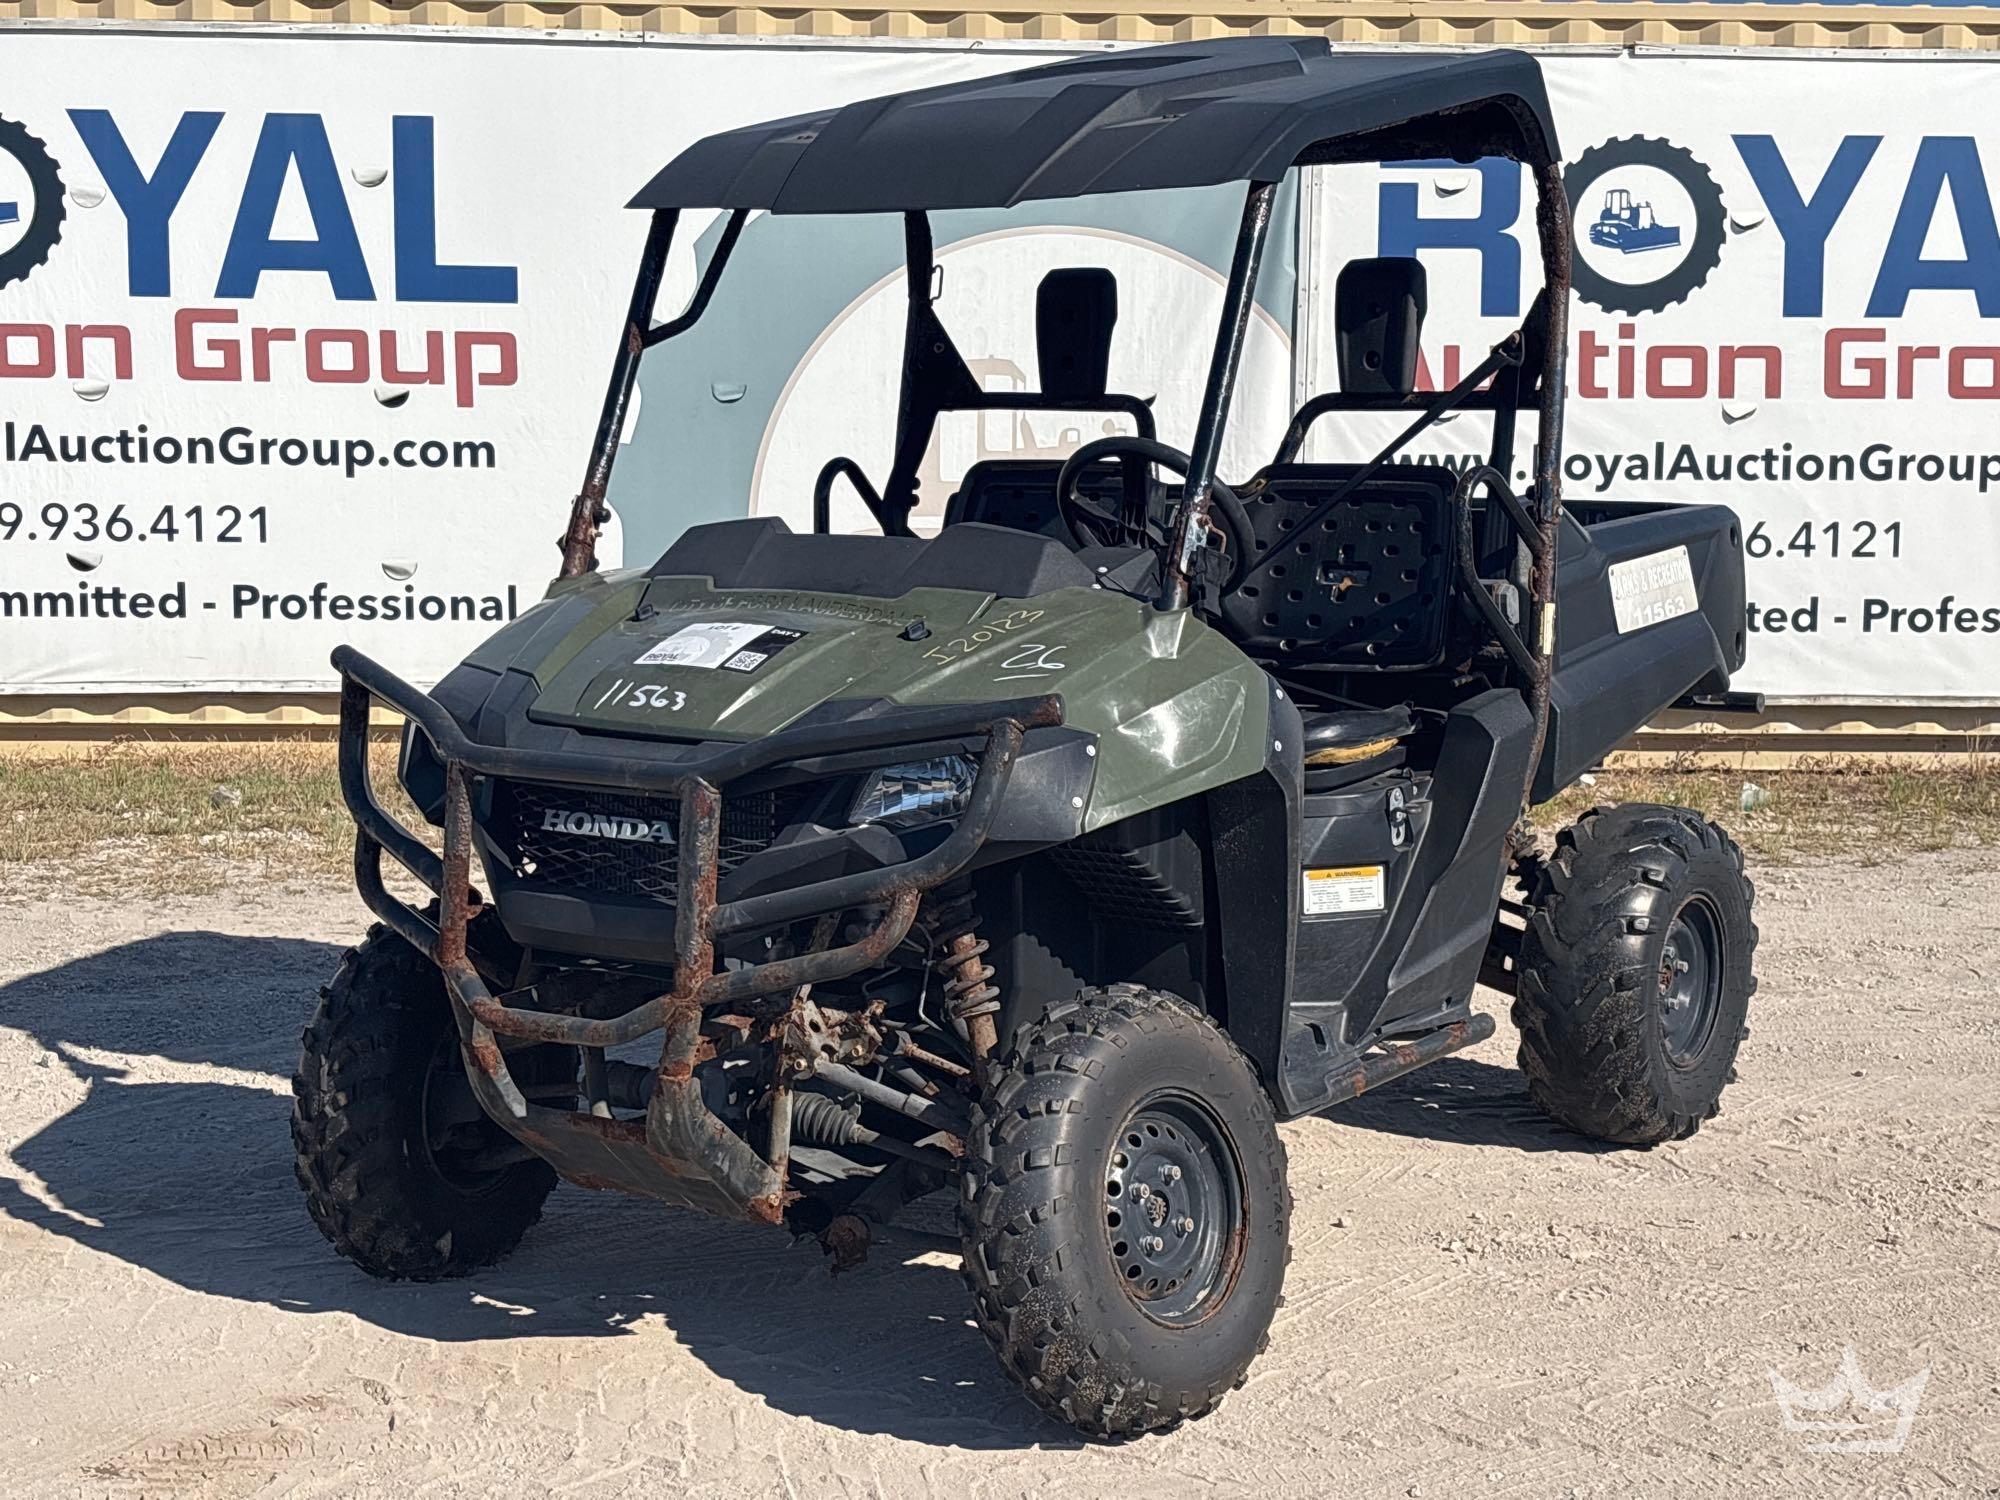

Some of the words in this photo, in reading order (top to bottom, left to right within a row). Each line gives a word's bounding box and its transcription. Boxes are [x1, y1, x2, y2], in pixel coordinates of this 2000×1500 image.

[0, 323, 133, 379] on
[174, 308, 518, 408] Group
[1824, 328, 2000, 399] Gro
[5, 421, 496, 478] lAuctionGroup.com
[0, 502, 268, 544] 9.936.4121
[1745, 521, 1901, 558] 6.4121
[1612, 572, 1641, 600] PARKS
[1648, 558, 1690, 591] RECREATION
[232, 584, 518, 622] Professional
[1862, 596, 2000, 632] Profes
[595, 679, 687, 711] 11563
[540, 808, 677, 844] HONDA
